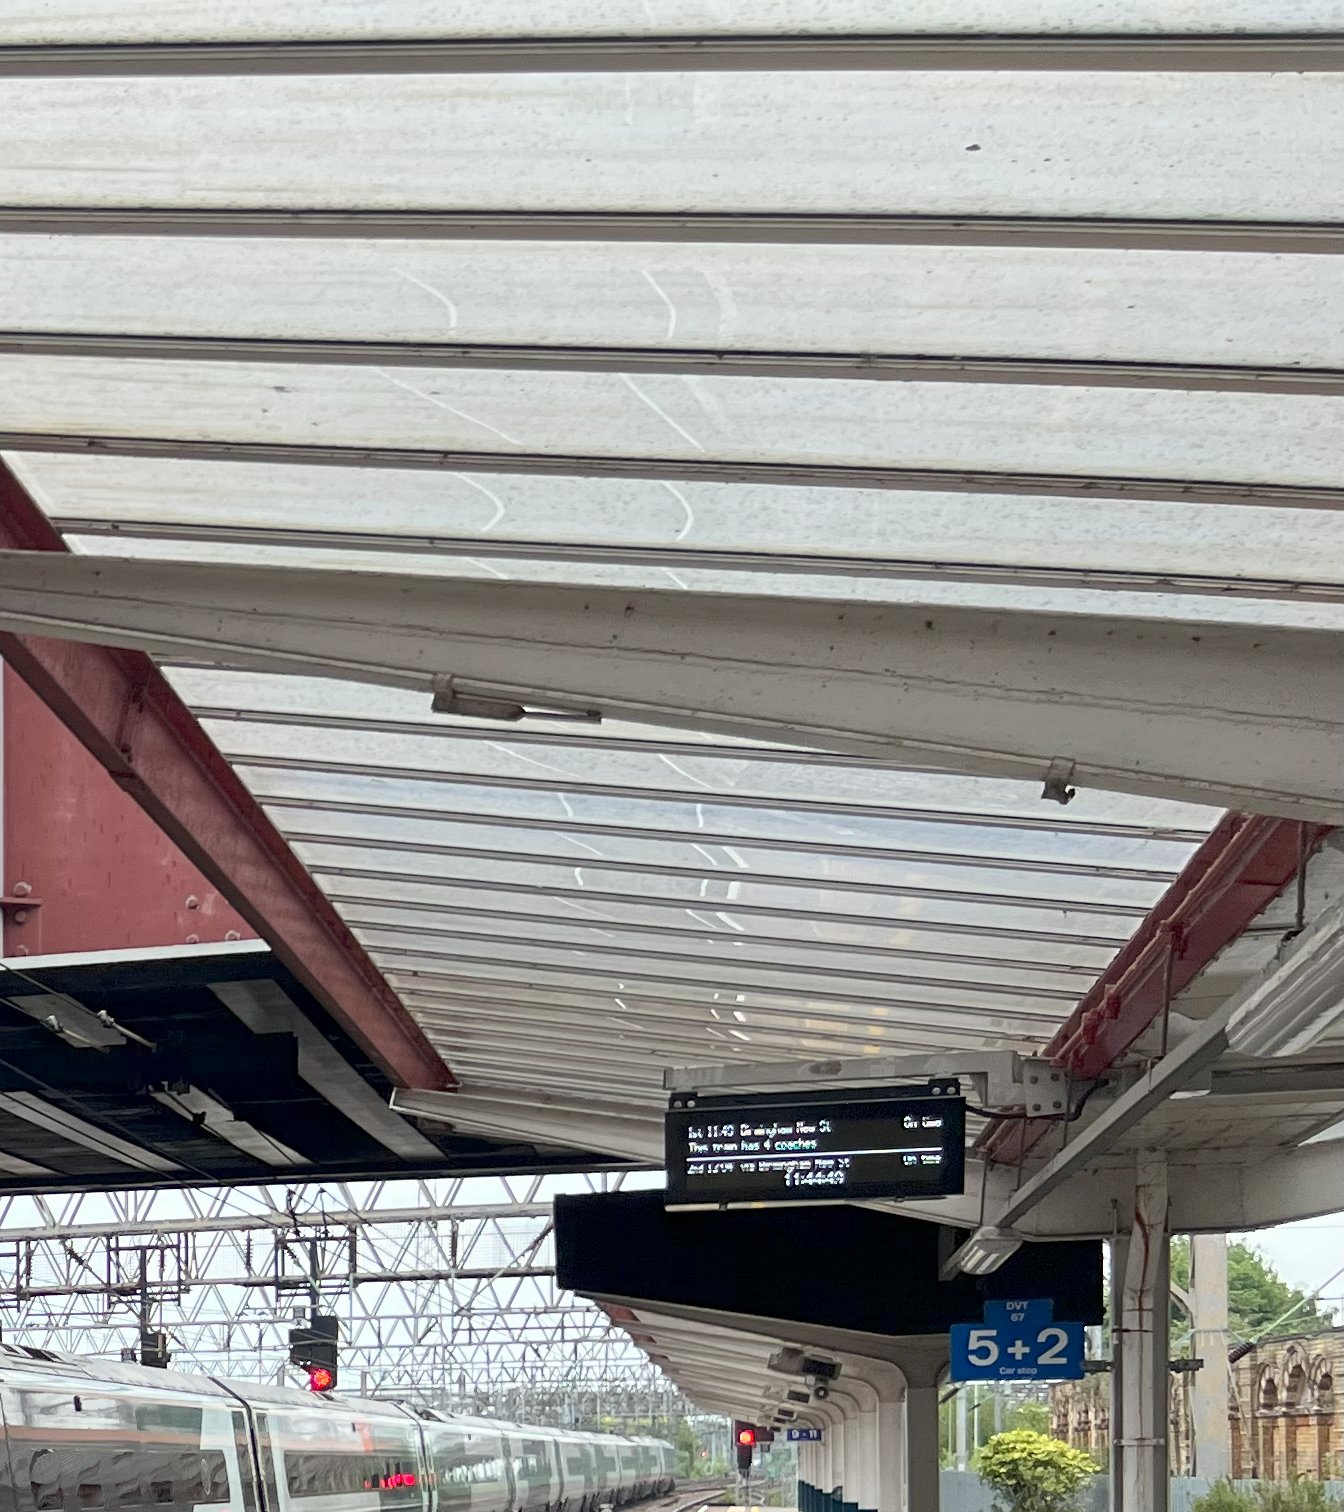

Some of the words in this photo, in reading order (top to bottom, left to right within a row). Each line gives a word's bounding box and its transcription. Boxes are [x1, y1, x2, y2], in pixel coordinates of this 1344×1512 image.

[741, 1139, 761, 1151] has
[763, 1139, 772, 1151] 4
[774, 1137, 818, 1151] coaches
[1006, 1301, 1029, 1311] DVT
[1011, 1313, 1025, 1322] 67
[999, 1367, 1016, 1375] Car
[1017, 1367, 1038, 1376] stop
